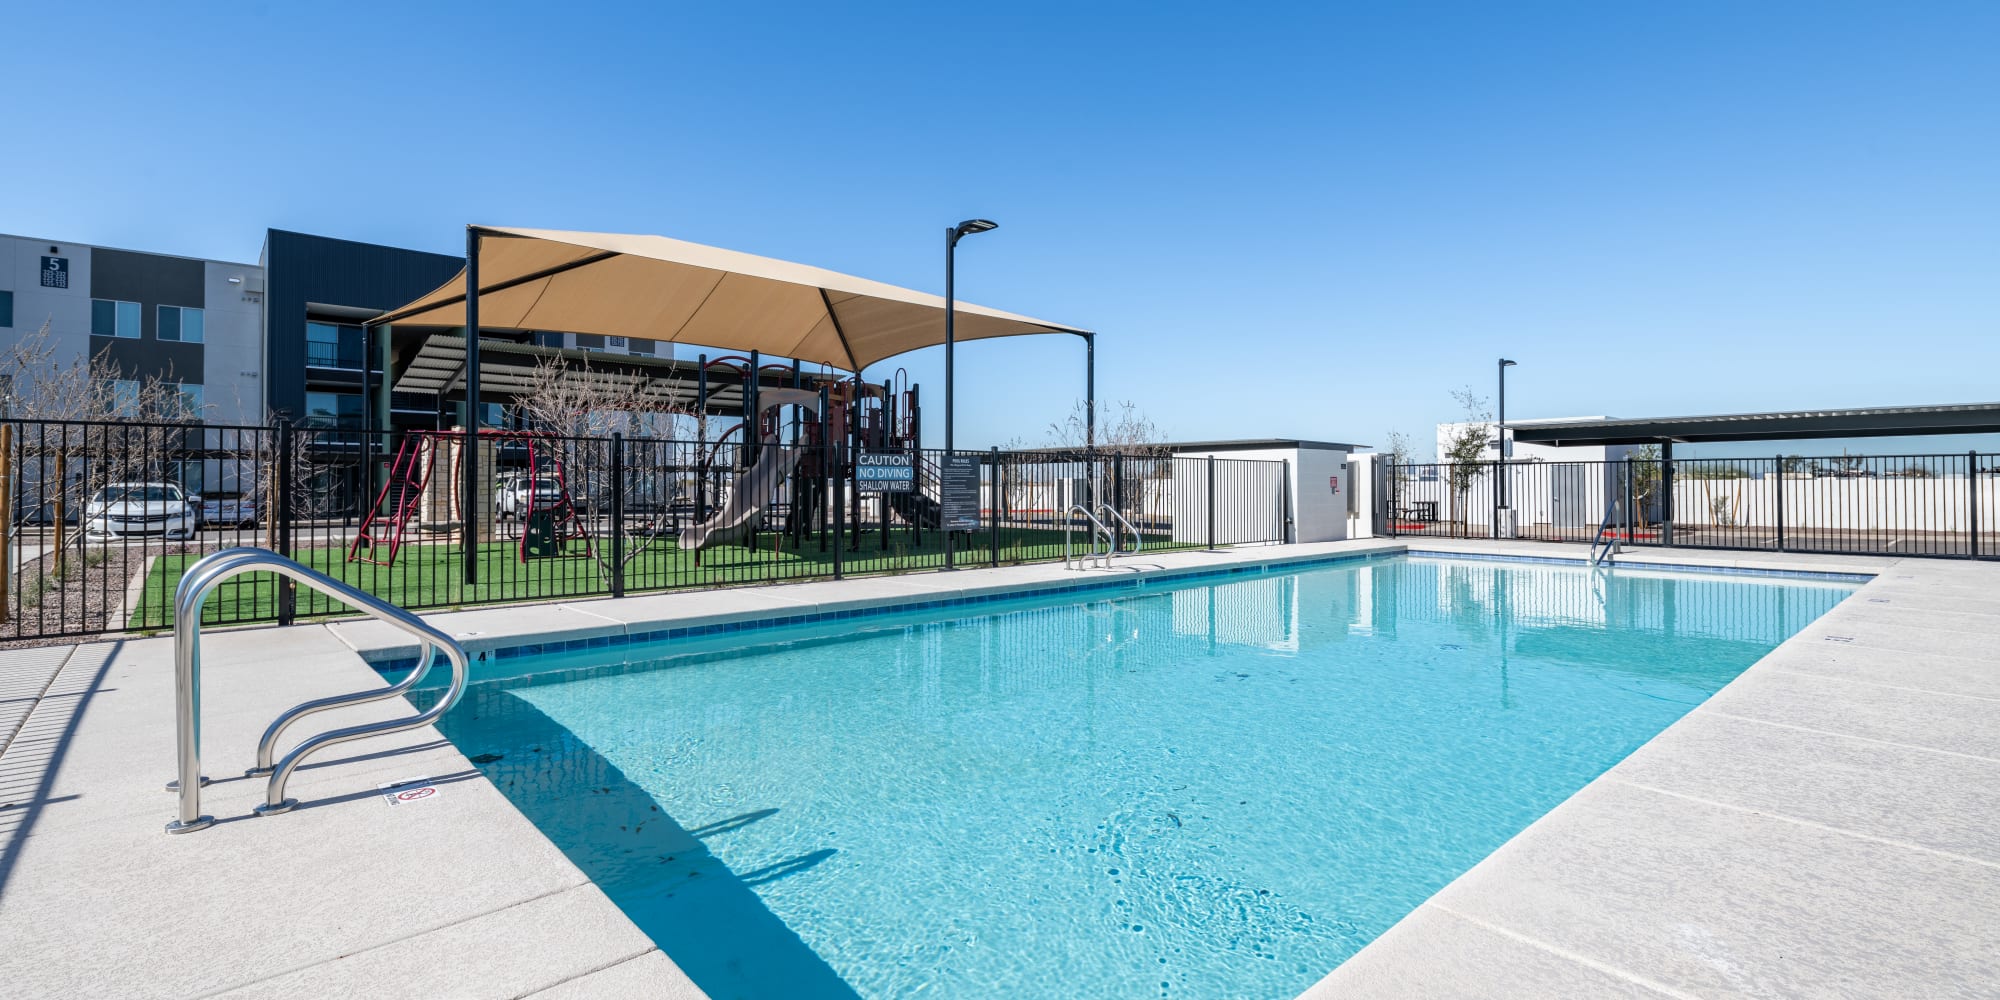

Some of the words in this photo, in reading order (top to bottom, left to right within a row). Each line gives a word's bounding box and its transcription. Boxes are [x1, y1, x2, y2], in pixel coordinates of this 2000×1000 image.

[49, 257, 59, 270] 5
[859, 455, 909, 466] CAUTION
[860, 468, 875, 478] NO
[877, 468, 910, 478] DIVING
[860, 480, 888, 490] SHALLOW
[890, 480, 910, 490] WATER
